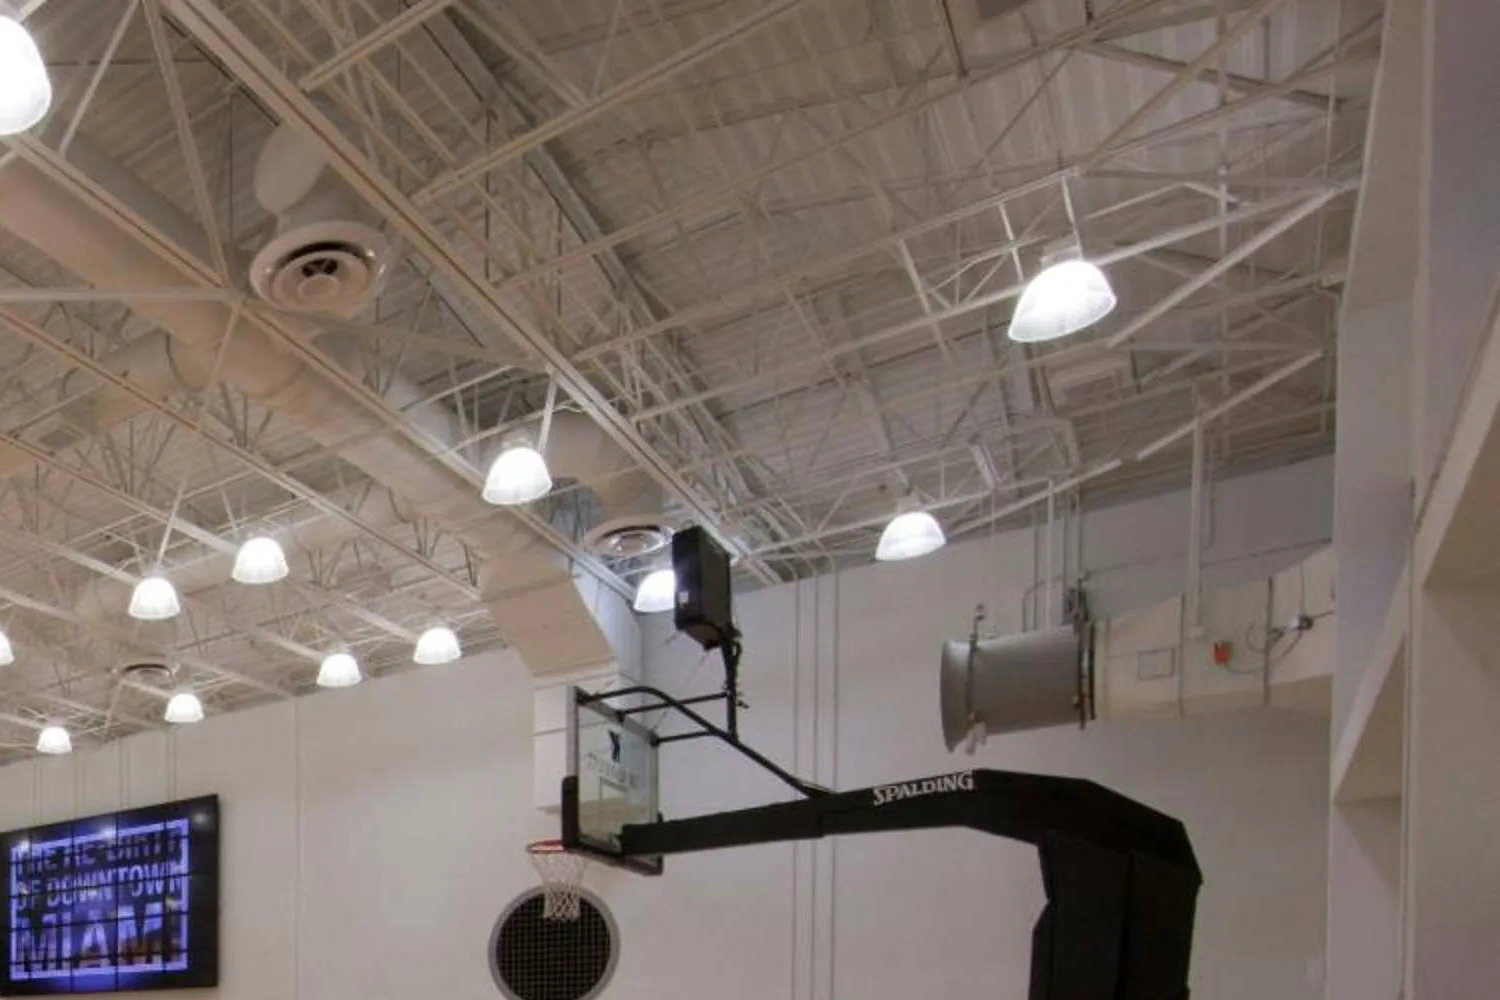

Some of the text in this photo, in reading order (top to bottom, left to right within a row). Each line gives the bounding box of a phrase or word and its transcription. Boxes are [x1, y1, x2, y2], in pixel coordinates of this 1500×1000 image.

[873, 770, 973, 807] SPALDING
[47, 861, 182, 907] DOWNTOWN
[16, 901, 182, 973] MIAMI
